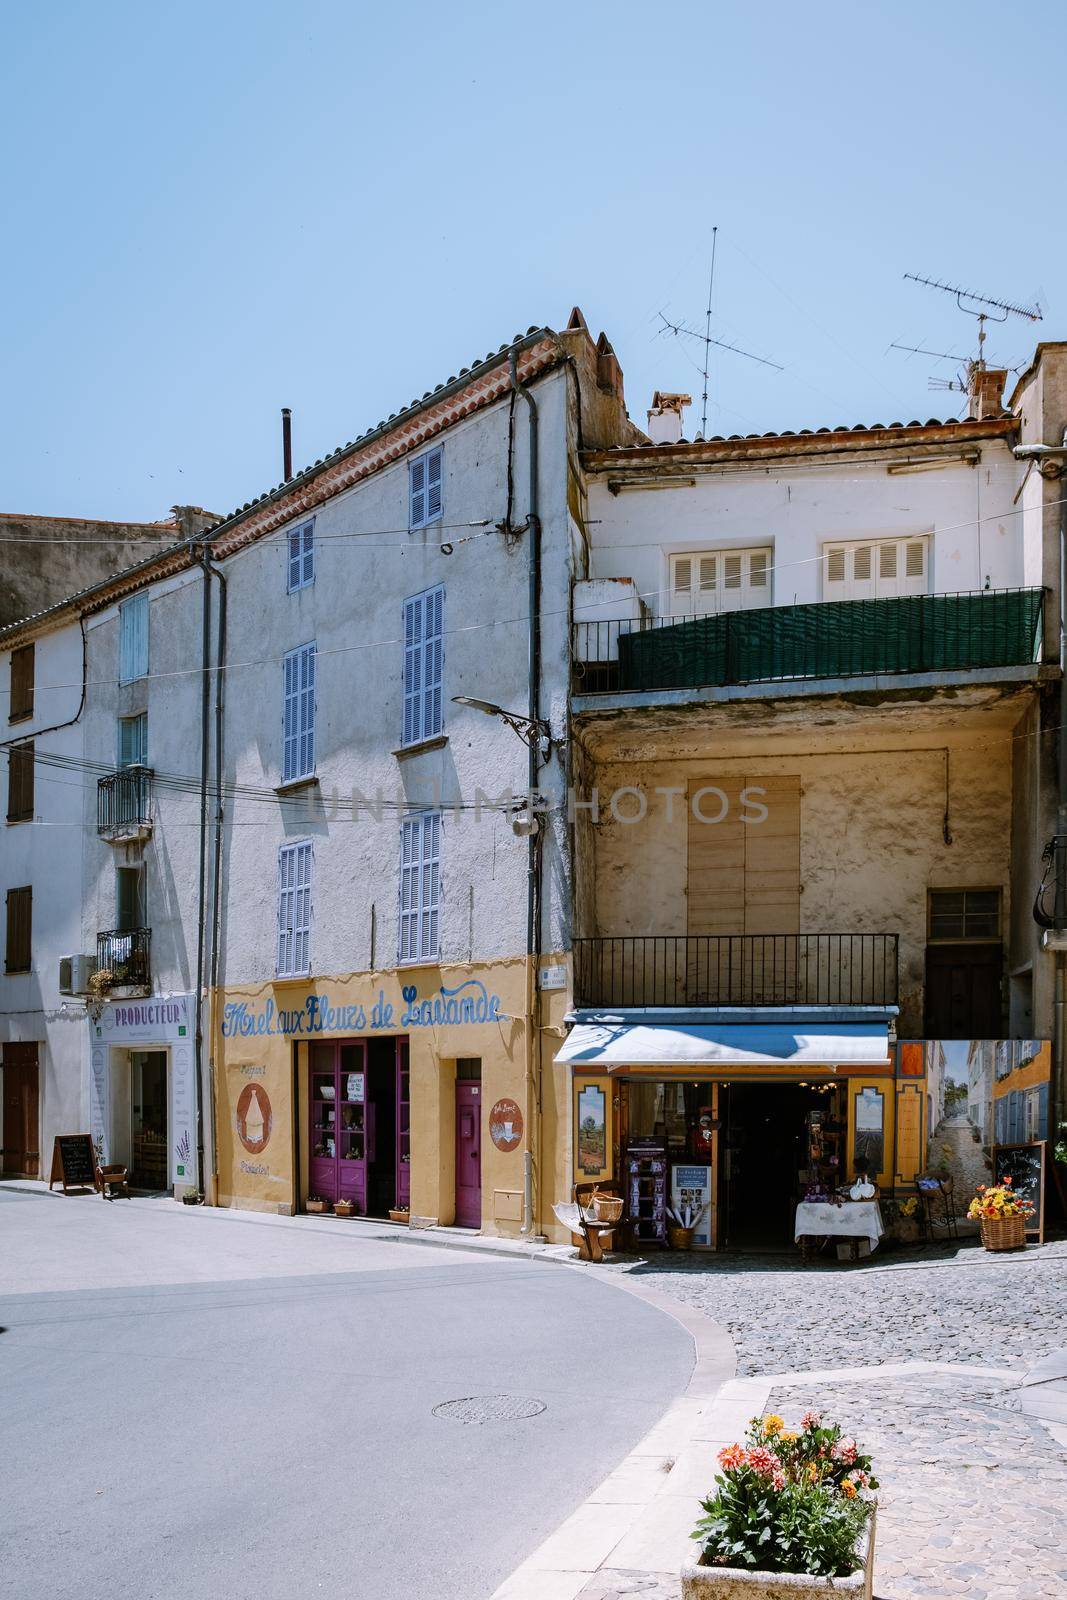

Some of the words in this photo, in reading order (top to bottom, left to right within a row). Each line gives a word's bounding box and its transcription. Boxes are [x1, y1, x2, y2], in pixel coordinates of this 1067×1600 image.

[115, 1004, 180, 1027] PRODUCTEUR
[221, 997, 274, 1038] Miel
[275, 1009, 305, 1035] aux
[305, 994, 367, 1034] Fleurs
[370, 989, 397, 1028] de
[401, 980, 509, 1027] Lavande
